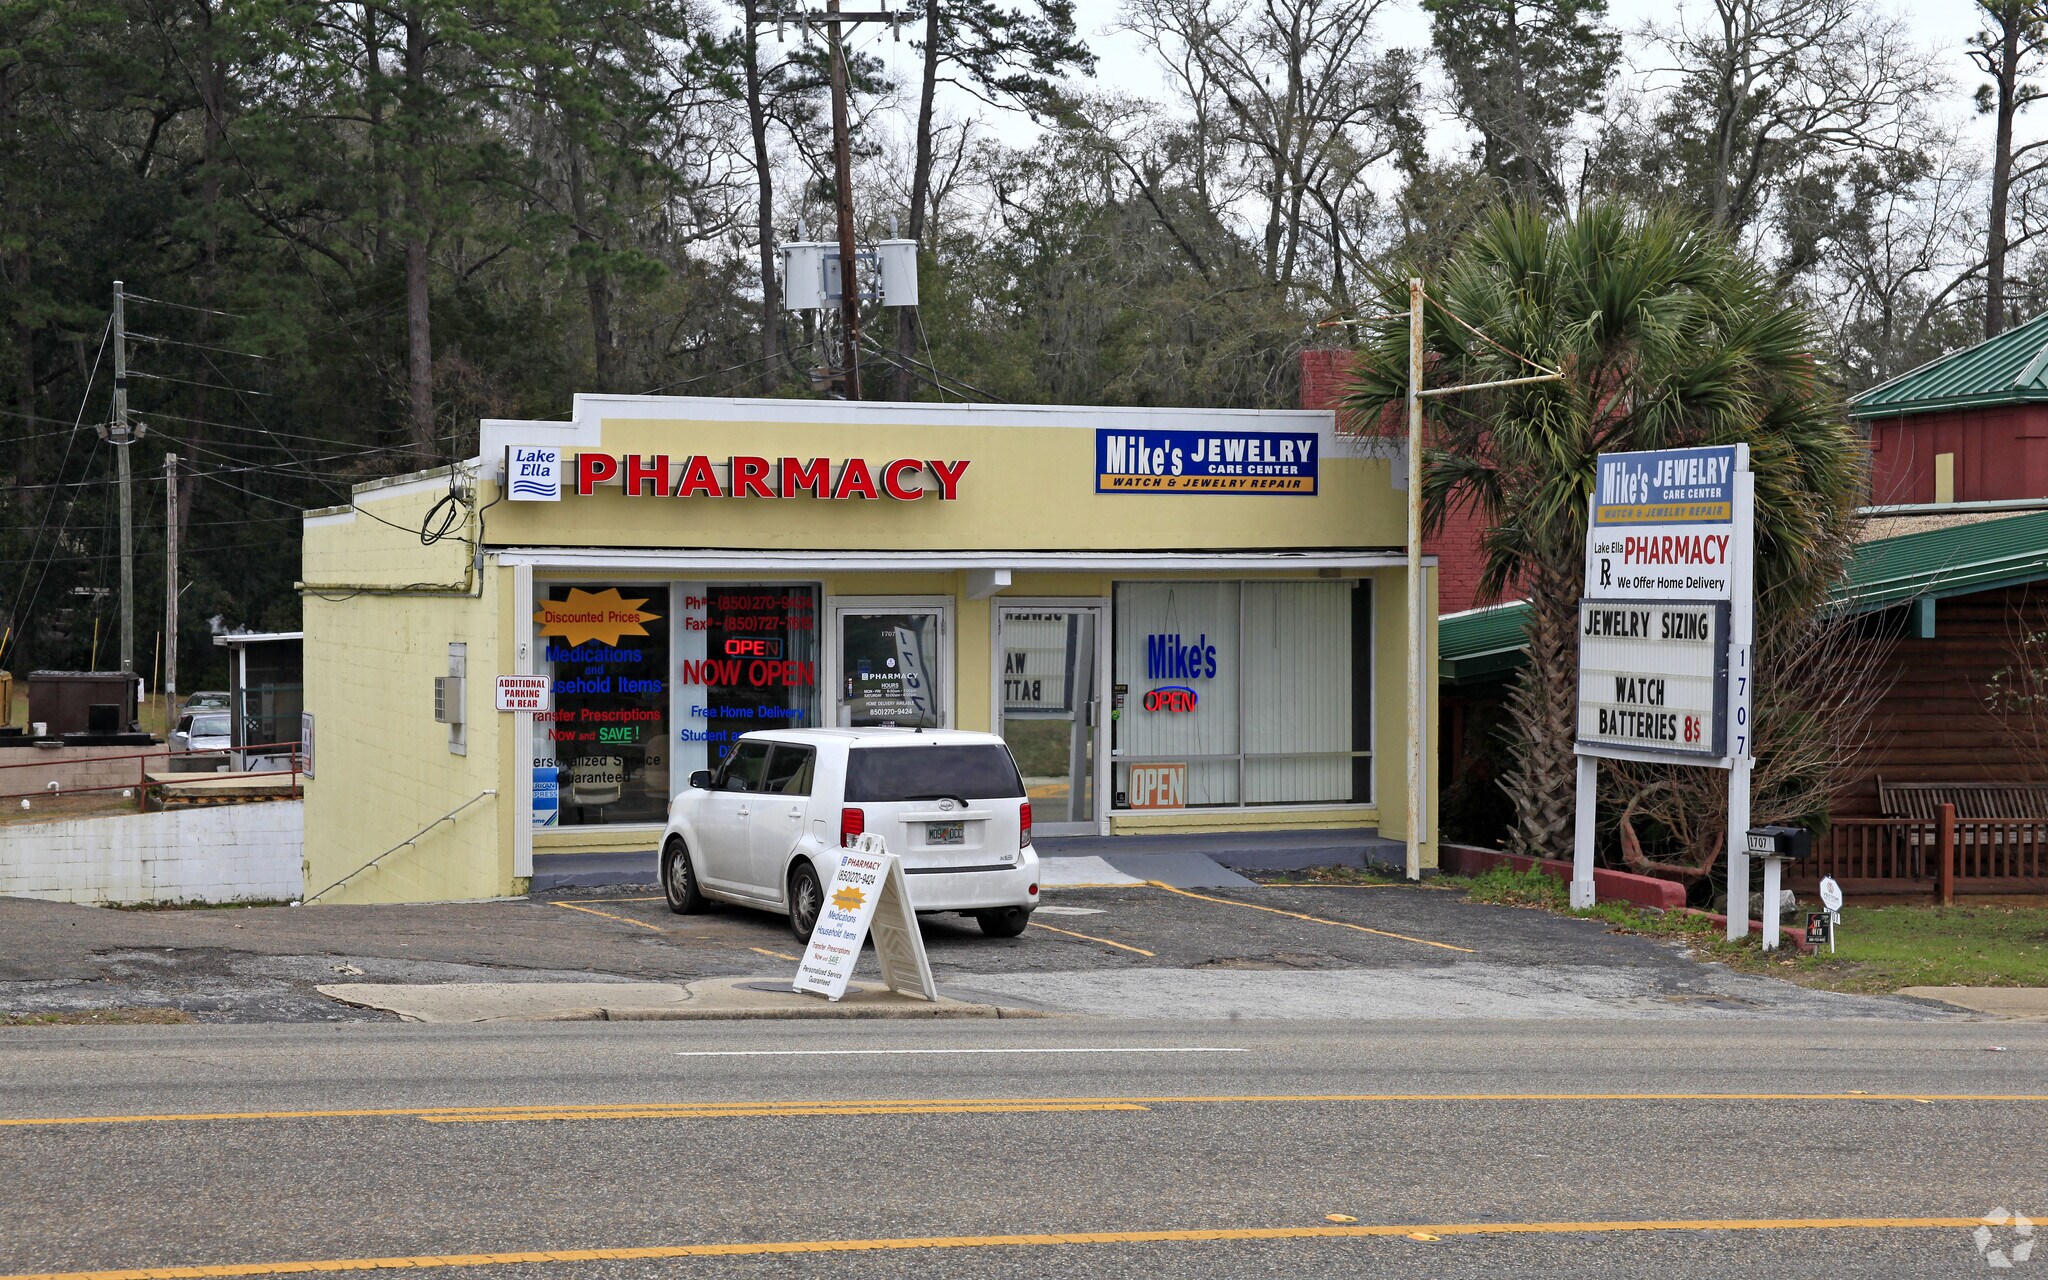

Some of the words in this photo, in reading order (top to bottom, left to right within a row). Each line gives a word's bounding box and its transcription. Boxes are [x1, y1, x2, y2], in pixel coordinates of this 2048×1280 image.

[516, 449, 555, 463] Lake
[1106, 435, 1183, 476] Mike's
[1190, 438, 1313, 463] JEWELRY
[520, 464, 550, 477] Ella
[575, 453, 972, 501] PHARMACY
[1208, 464, 1243, 474] CARE
[1247, 464, 1299, 475] CENTER
[1113, 477, 1162, 487] WATCH
[1167, 478, 1177, 487] &
[1183, 478, 1247, 488] JEWELRY
[1250, 479, 1303, 489] REPAIR
[1602, 462, 1648, 505] Mike's
[1652, 456, 1730, 488] JEWELRY
[1663, 489, 1685, 500] CARE
[1687, 487, 1722, 499] CENTER
[1604, 507, 1632, 519] WATCH
[1645, 506, 1686, 518] JEWELRY
[1688, 505, 1723, 517] REPAIR
[1594, 542, 1610, 554] Lake
[1611, 541, 1624, 554] Ella
[1624, 534, 1730, 565] PHARMACY
[1617, 577, 1631, 589] We
[1633, 576, 1655, 589] Offer
[1657, 577, 1684, 589] Home
[1686, 576, 1725, 592] Delivery
[545, 611, 604, 623] Discounted
[608, 611, 641, 623] Prices
[1585, 610, 1650, 638] JEWELRY
[1661, 612, 1709, 640] SIZING
[545, 645, 643, 663] Medications
[725, 639, 778, 656] OPEN
[1147, 633, 1217, 679] Mike's
[584, 665, 605, 675] and
[683, 659, 742, 686] NOW
[748, 660, 815, 686] OPEN
[870, 672, 918, 680] PHARMACY
[499, 679, 546, 688] ADDITIONAL
[618, 678, 662, 694] Items
[1615, 676, 1665, 706] WATCH
[505, 690, 540, 698] PARKING
[1144, 690, 1196, 713] OPEN
[1737, 648, 1747, 755] 1707
[506, 699, 515, 708] IN
[517, 699, 538, 708] REAR
[532, 708, 576, 722] ransfer
[581, 708, 661, 723] Prescriptions
[691, 705, 717, 718] Free
[720, 705, 754, 719] Home
[757, 705, 805, 720] Delivery
[1599, 708, 1677, 741] BATTERIES
[548, 728, 576, 741] Now
[578, 731, 596, 741] and
[681, 728, 726, 742] Student
[1132, 767, 1184, 806] OPEN
[1749, 837, 1767, 848] 1707
[847, 857, 882, 870] PHARMACY
[828, 909, 857, 924] Medications
[817, 925, 842, 938] Household
[842, 929, 857, 941] Items
[812, 941, 827, 950] Transfer
[827, 944, 851, 956] Prescriptions
[808, 975, 832, 987] Guaranteed
[827, 969, 843, 980] Service
